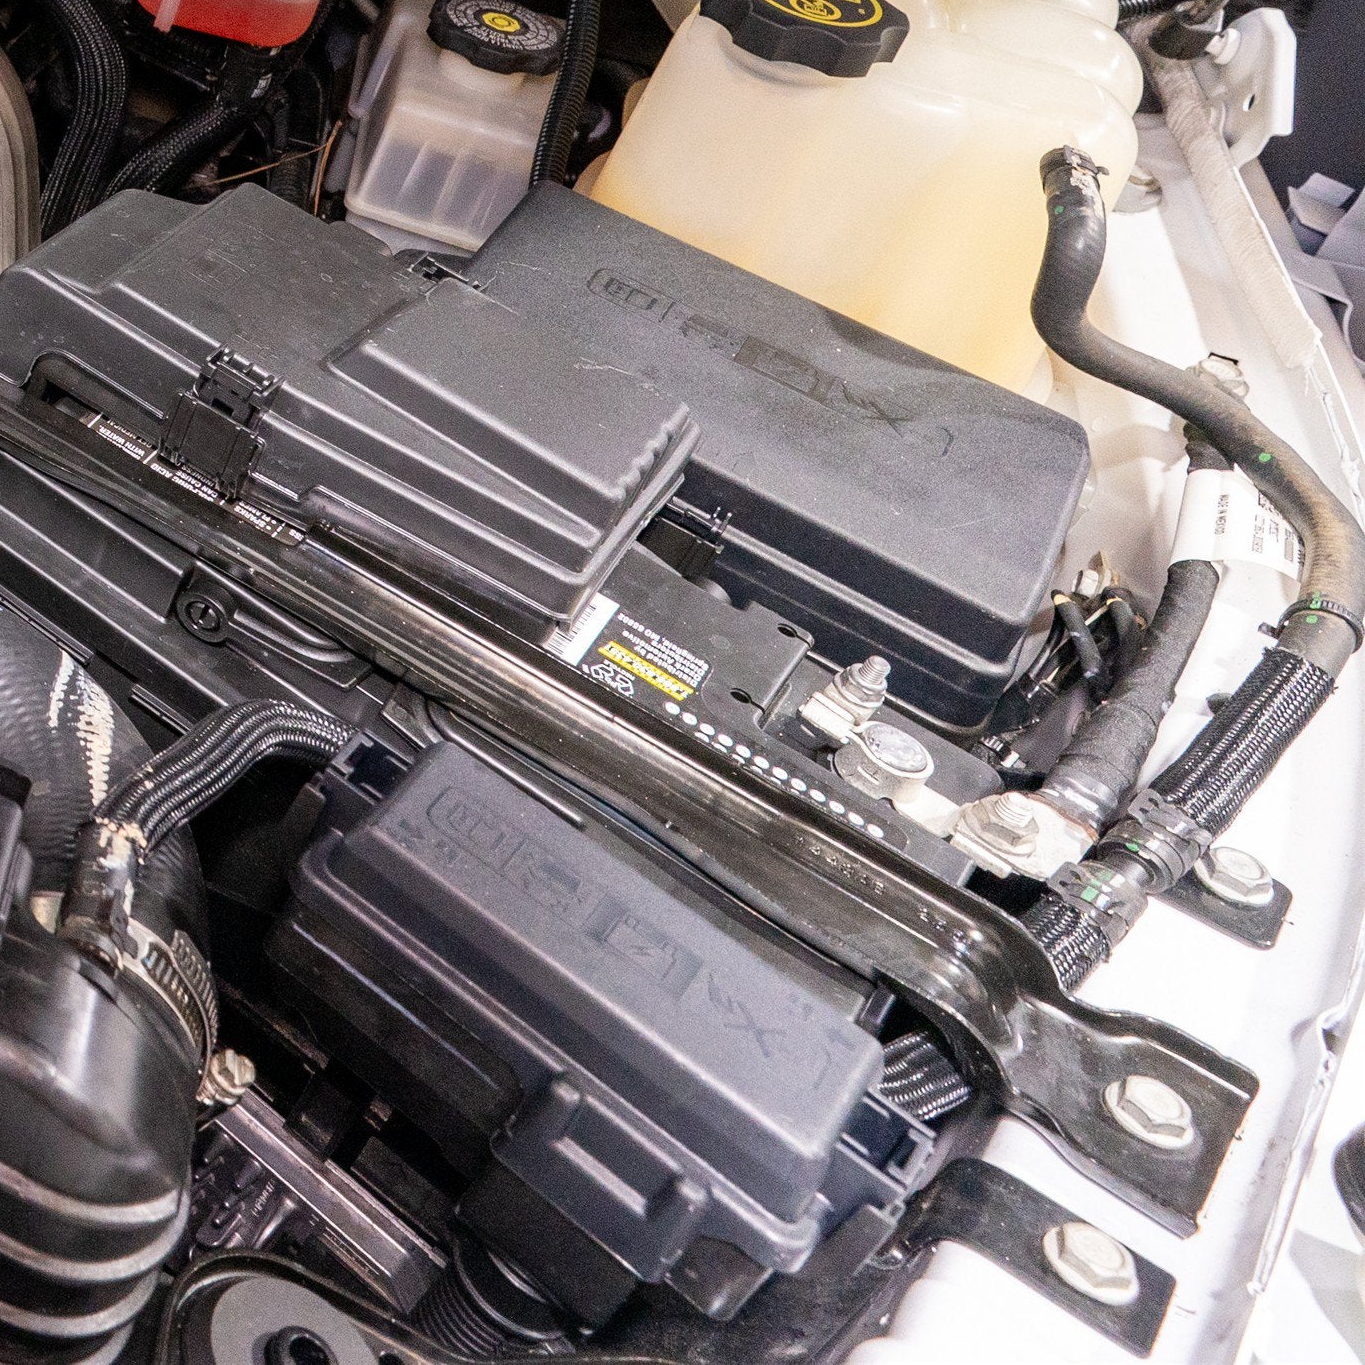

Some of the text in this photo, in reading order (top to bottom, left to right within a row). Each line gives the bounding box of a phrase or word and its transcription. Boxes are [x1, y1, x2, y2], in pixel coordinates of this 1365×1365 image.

[98, 424, 126, 445] WATER.
[124, 441, 146, 457] WITH
[150, 462, 173, 479] ACID
[175, 469, 219, 498] CAN CAUSE
[233, 505, 267, 528] SPARKS
[621, 630, 675, 664] Automotive
[633, 645, 647, 657] by
[650, 640, 706, 677] Distributors
[645, 652, 699, 688] Distributed
